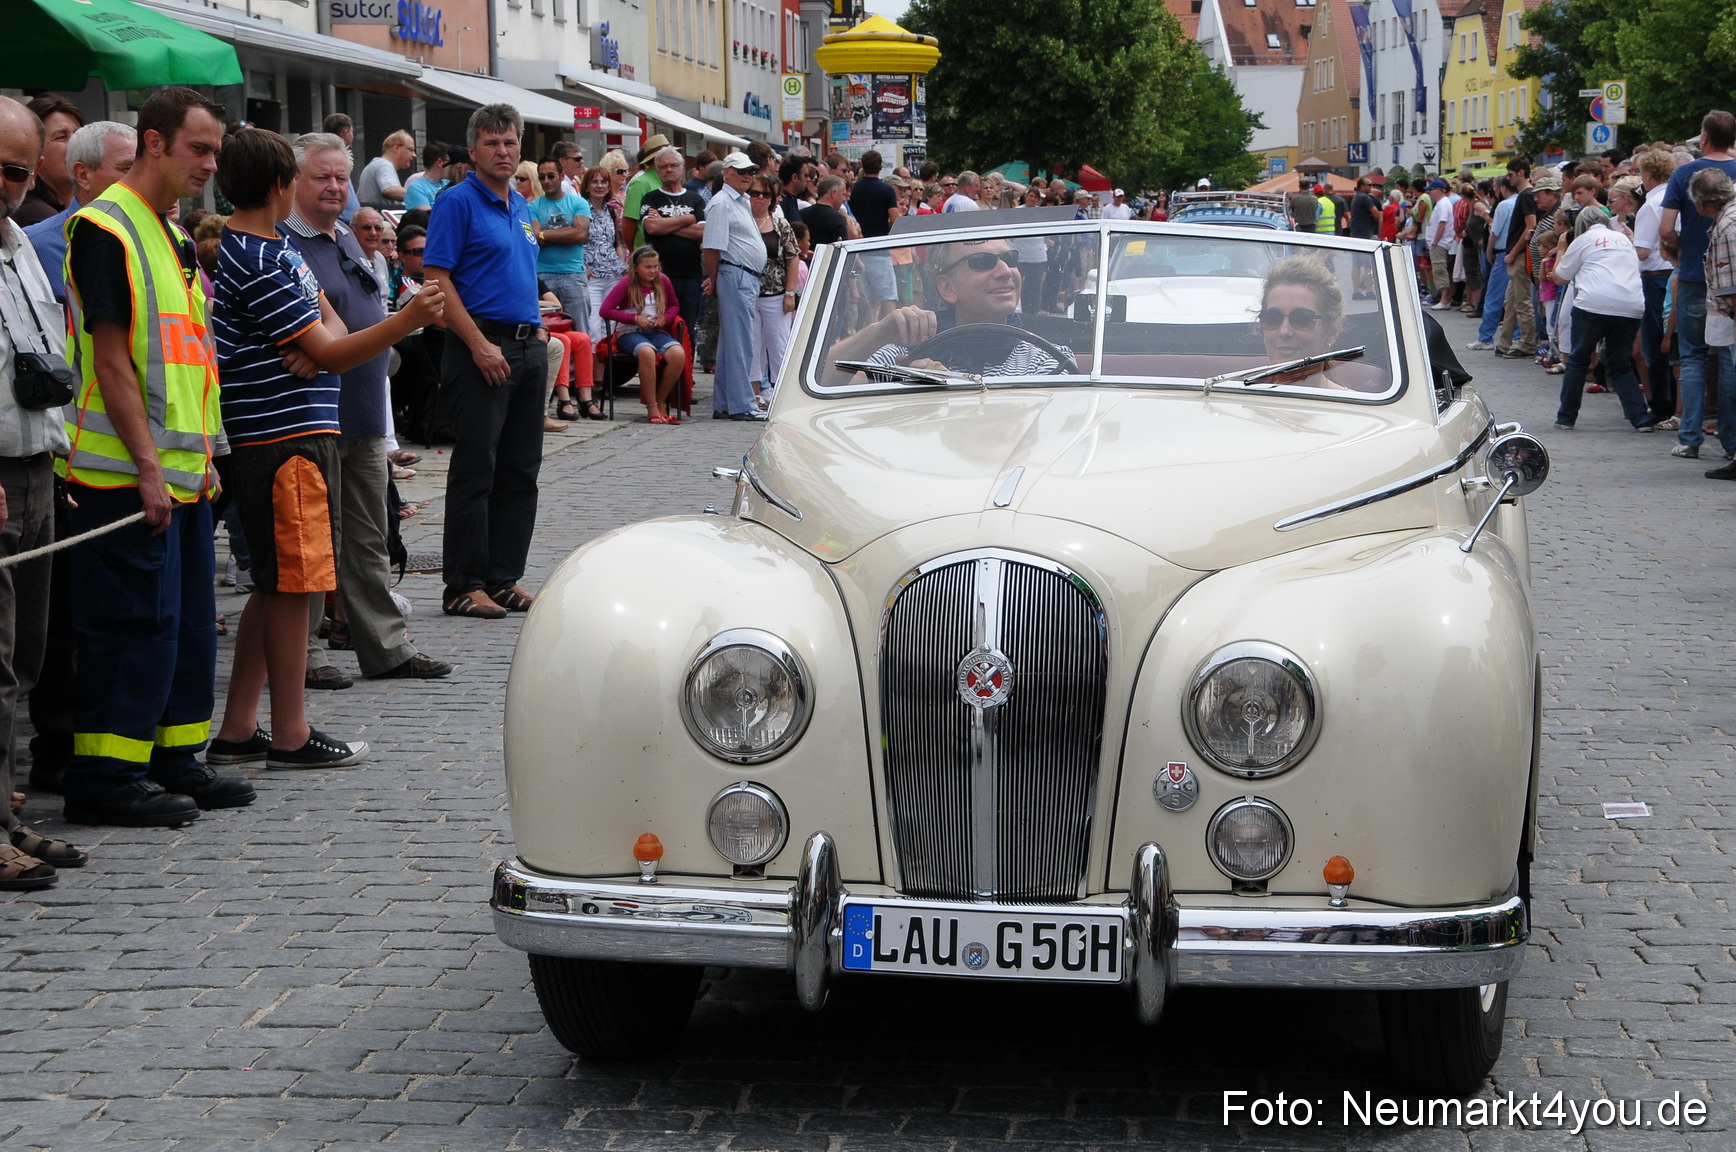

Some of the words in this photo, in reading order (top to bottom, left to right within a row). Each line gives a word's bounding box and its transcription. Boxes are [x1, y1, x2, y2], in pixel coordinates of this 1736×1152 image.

[331, 0, 393, 18] sutor.
[873, 914, 959, 967] LAU
[852, 943, 864, 958] D
